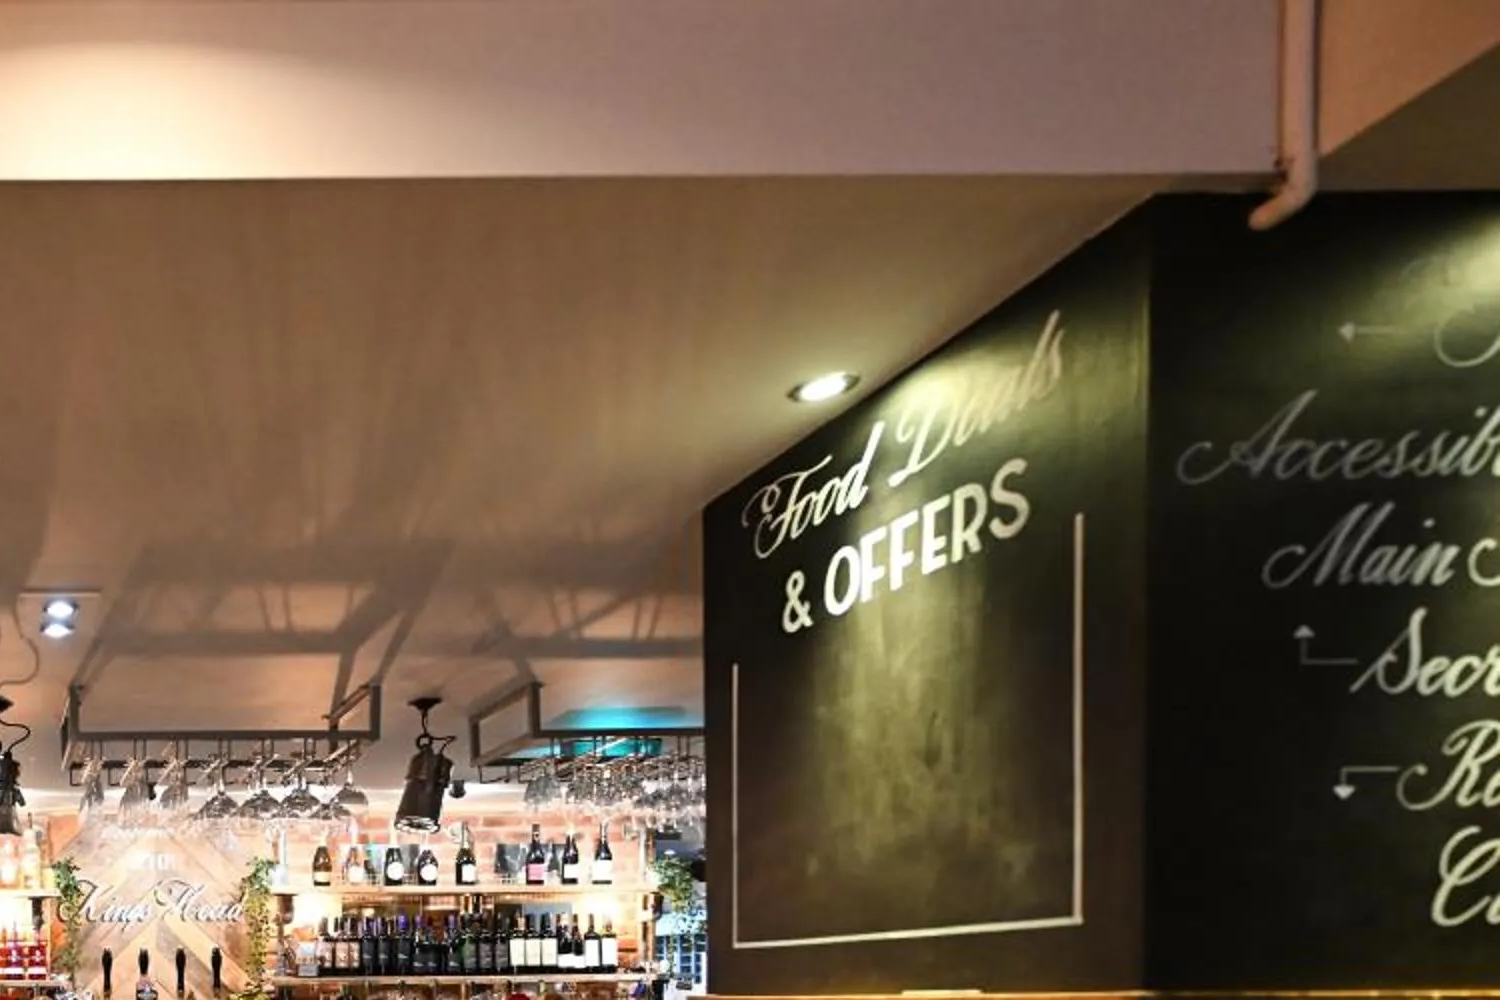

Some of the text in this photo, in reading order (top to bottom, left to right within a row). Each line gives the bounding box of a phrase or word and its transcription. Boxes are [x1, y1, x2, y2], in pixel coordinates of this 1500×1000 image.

[742, 309, 1066, 559] Food Deals
[782, 457, 1030, 633] & OFFERS
[1261, 501, 1461, 589] Main
[57, 879, 150, 933] Kings
